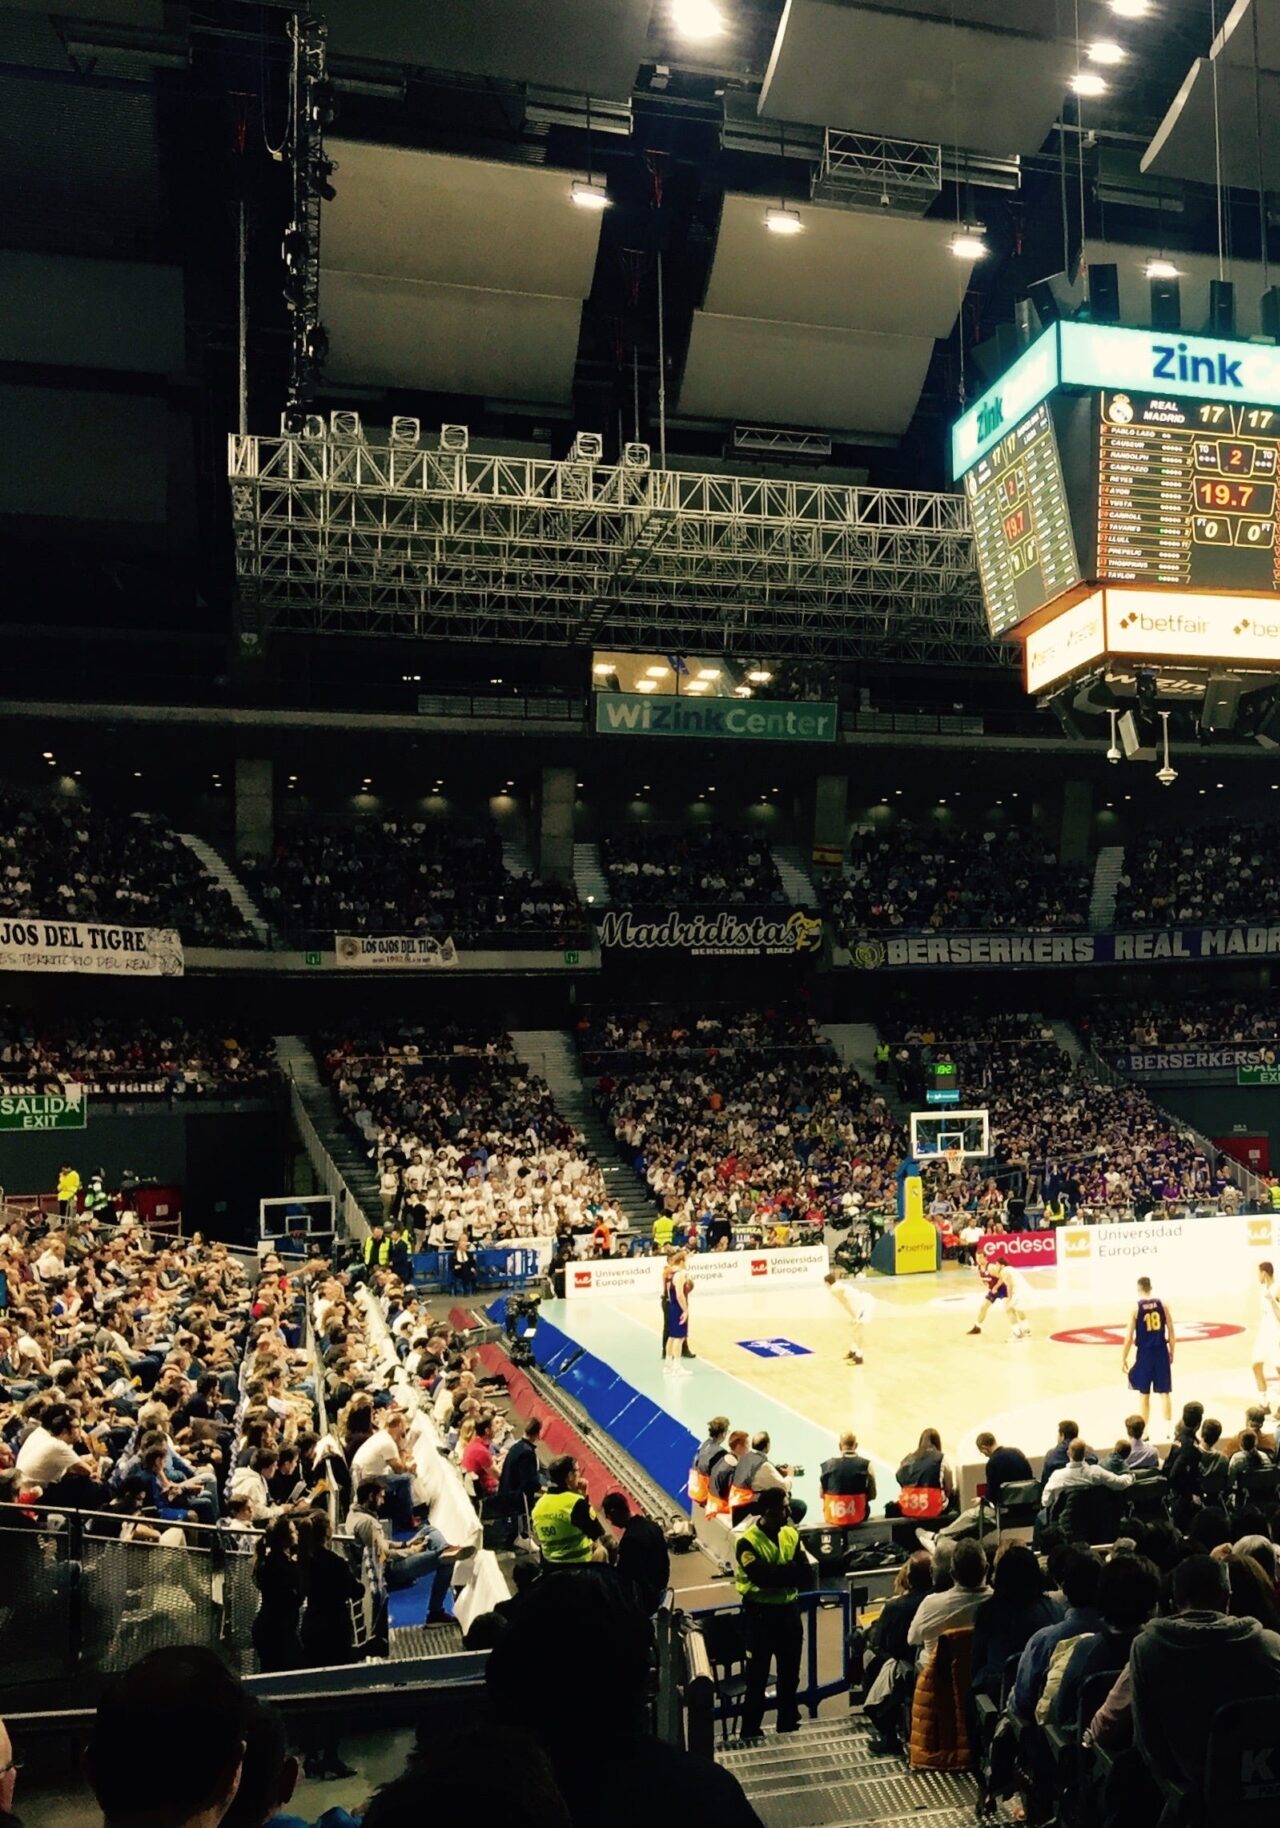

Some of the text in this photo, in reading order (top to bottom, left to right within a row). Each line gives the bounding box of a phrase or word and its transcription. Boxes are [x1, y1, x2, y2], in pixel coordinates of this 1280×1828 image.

[1149, 400, 1178, 411] REAL
[1200, 404, 1225, 423] 17
[1143, 411, 1185, 423] MADRID
[1248, 410, 1274, 429] 17
[1230, 449, 1242, 465] 2
[1200, 482, 1253, 508] 19.7
[1205, 522, 1218, 538] 0
[1247, 525, 1261, 541] 0
[1140, 612, 1210, 634] betfair
[599, 911, 799, 948] Madridistas
[43, 924, 84, 948] DEL
[88, 927, 147, 952] TIGRE
[361, 940, 377, 954] LOS
[379, 939, 399, 954] OJOS
[402, 940, 416, 954] DEL
[887, 935, 1096, 965] BERSERKERS
[1114, 929, 1190, 960] REAL
[19, 953, 93, 967] TERRITORIO
[97, 957, 122, 969] DEL
[1130, 1051, 1260, 1070] BERSERKERS
[0, 1097, 81, 1115] SALIDA
[23, 1114, 58, 1129] EXIT
[1098, 1225, 1183, 1242] Universidad
[984, 1236, 1056, 1256] endesa
[1098, 1243, 1158, 1257] Europea
[771, 1255, 823, 1266] Universidad
[595, 1266, 651, 1279] Universidad
[771, 1264, 808, 1275] Europea
[595, 1277, 635, 1289] Europea
[1143, 1311, 1161, 1332] 18
[829, 1499, 856, 1518] 164
